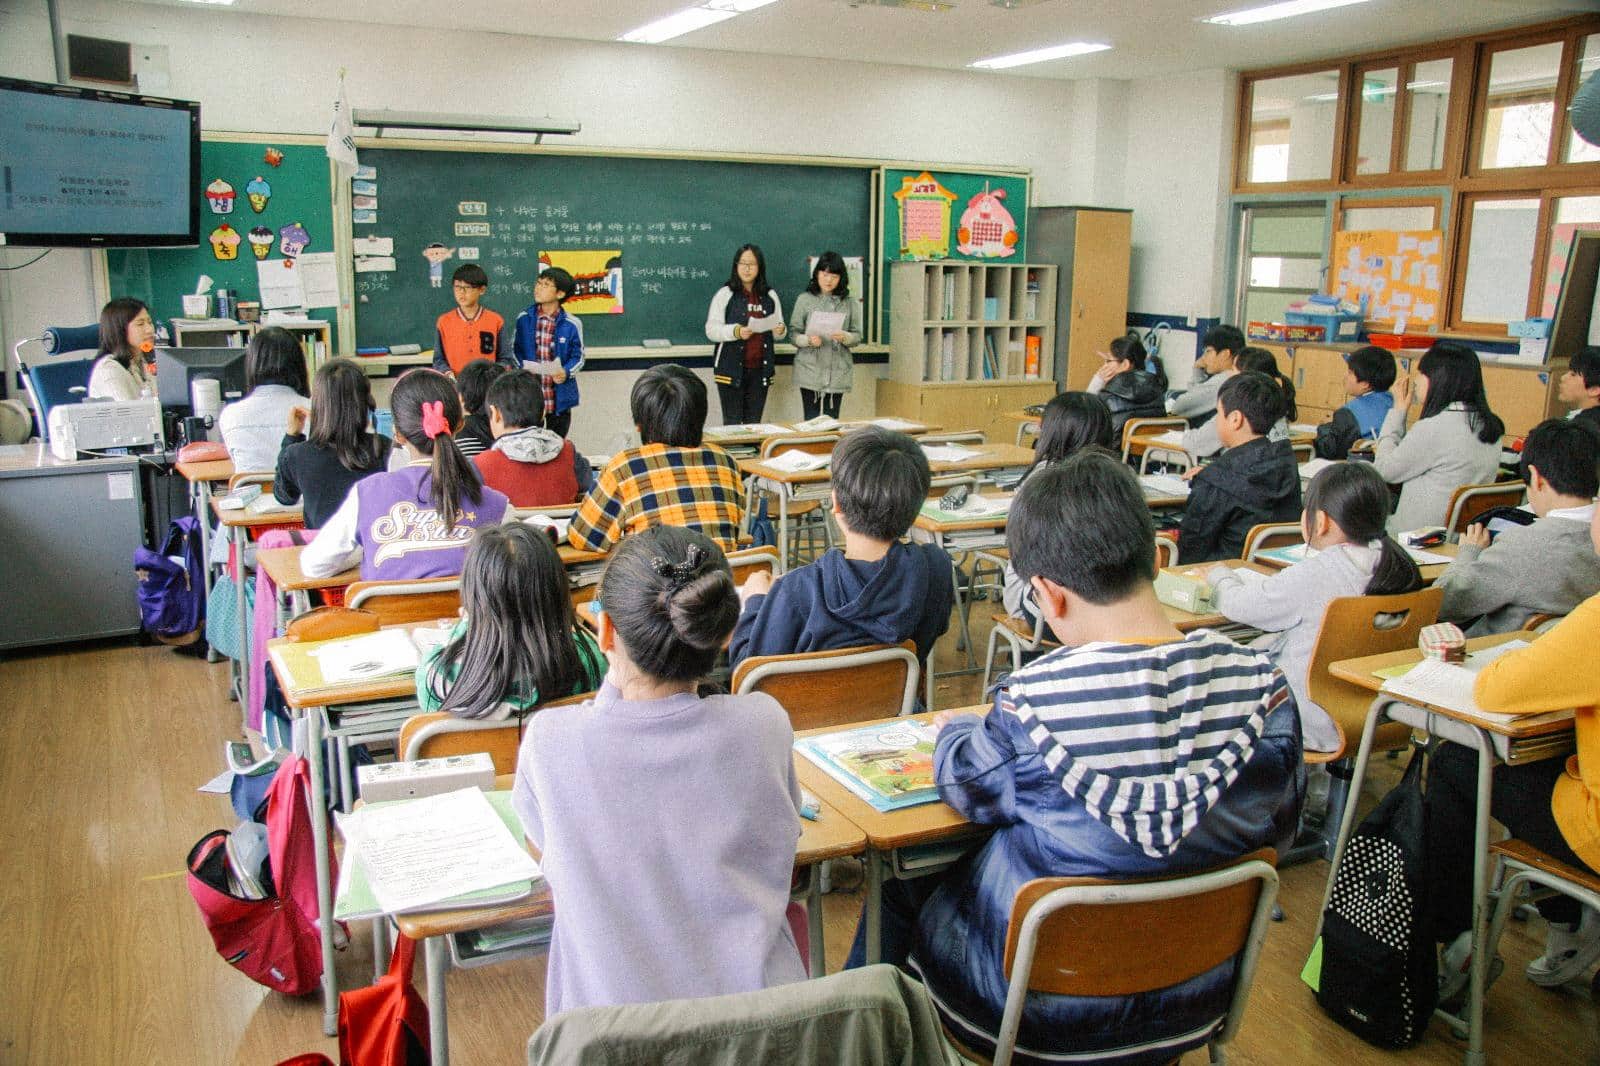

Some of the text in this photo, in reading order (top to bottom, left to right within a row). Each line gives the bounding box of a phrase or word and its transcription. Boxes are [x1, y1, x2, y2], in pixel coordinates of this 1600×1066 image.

[214, 198, 229, 212] 생
[254, 245, 269, 255] 하
[284, 242, 298, 254] 해
[479, 331, 495, 355] B
[373, 502, 464, 543] Supe
